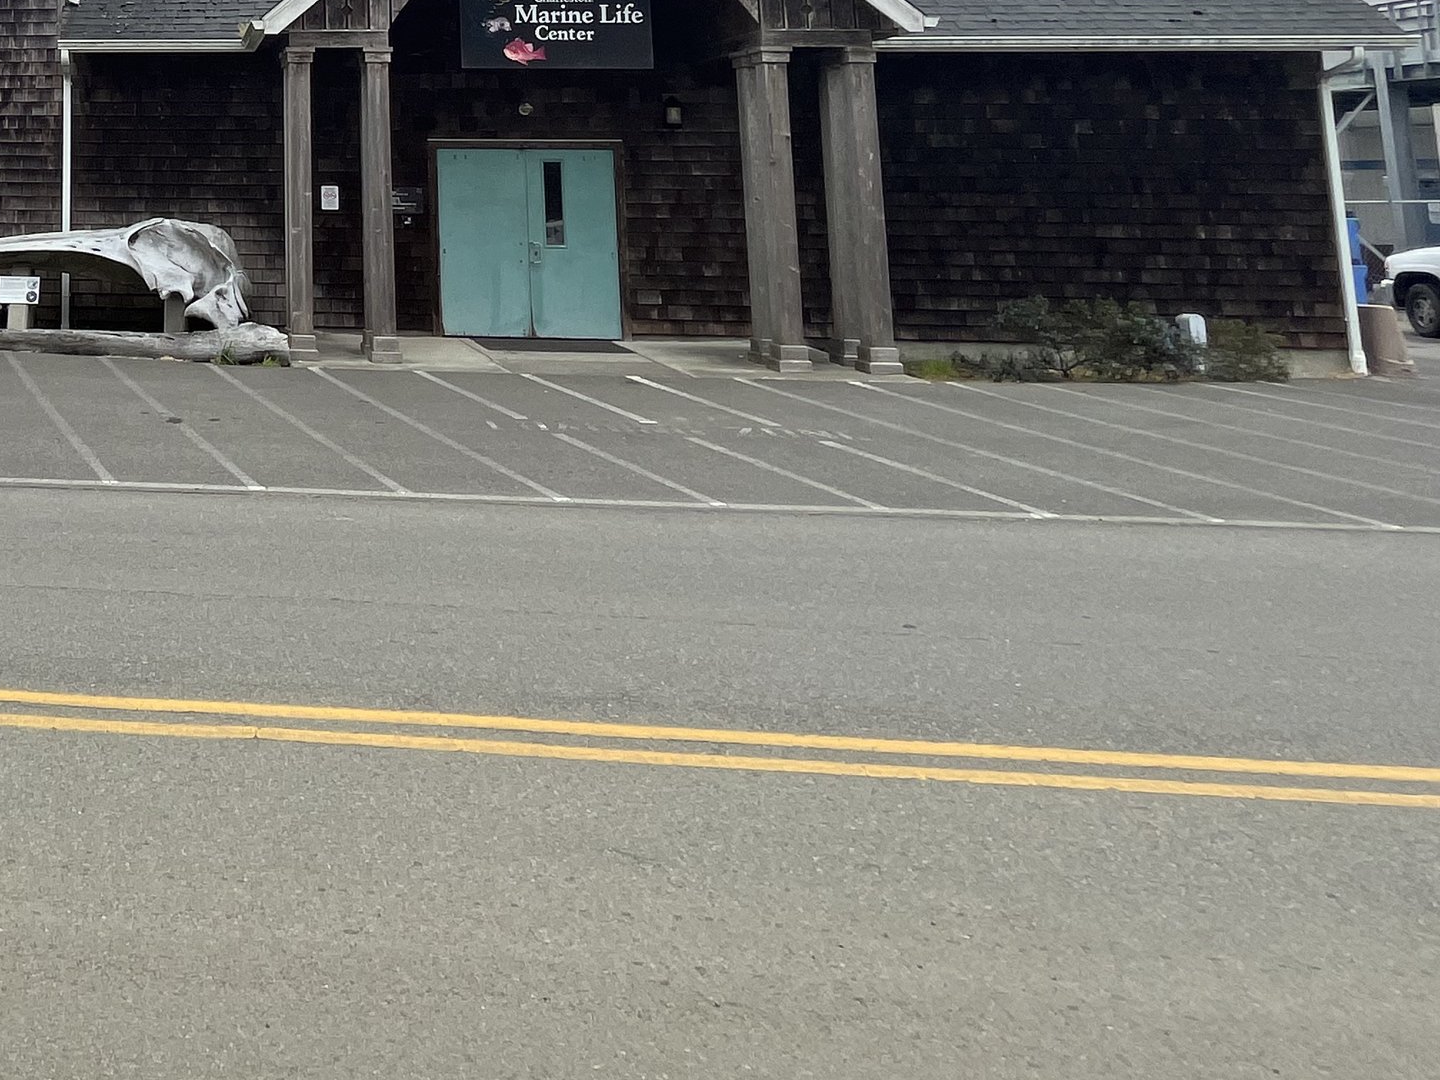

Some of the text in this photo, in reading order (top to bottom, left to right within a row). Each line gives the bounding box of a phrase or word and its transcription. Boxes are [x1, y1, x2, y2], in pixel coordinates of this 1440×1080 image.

[514, 3, 644, 24] Marine Life
[534, 25, 595, 41] Center
